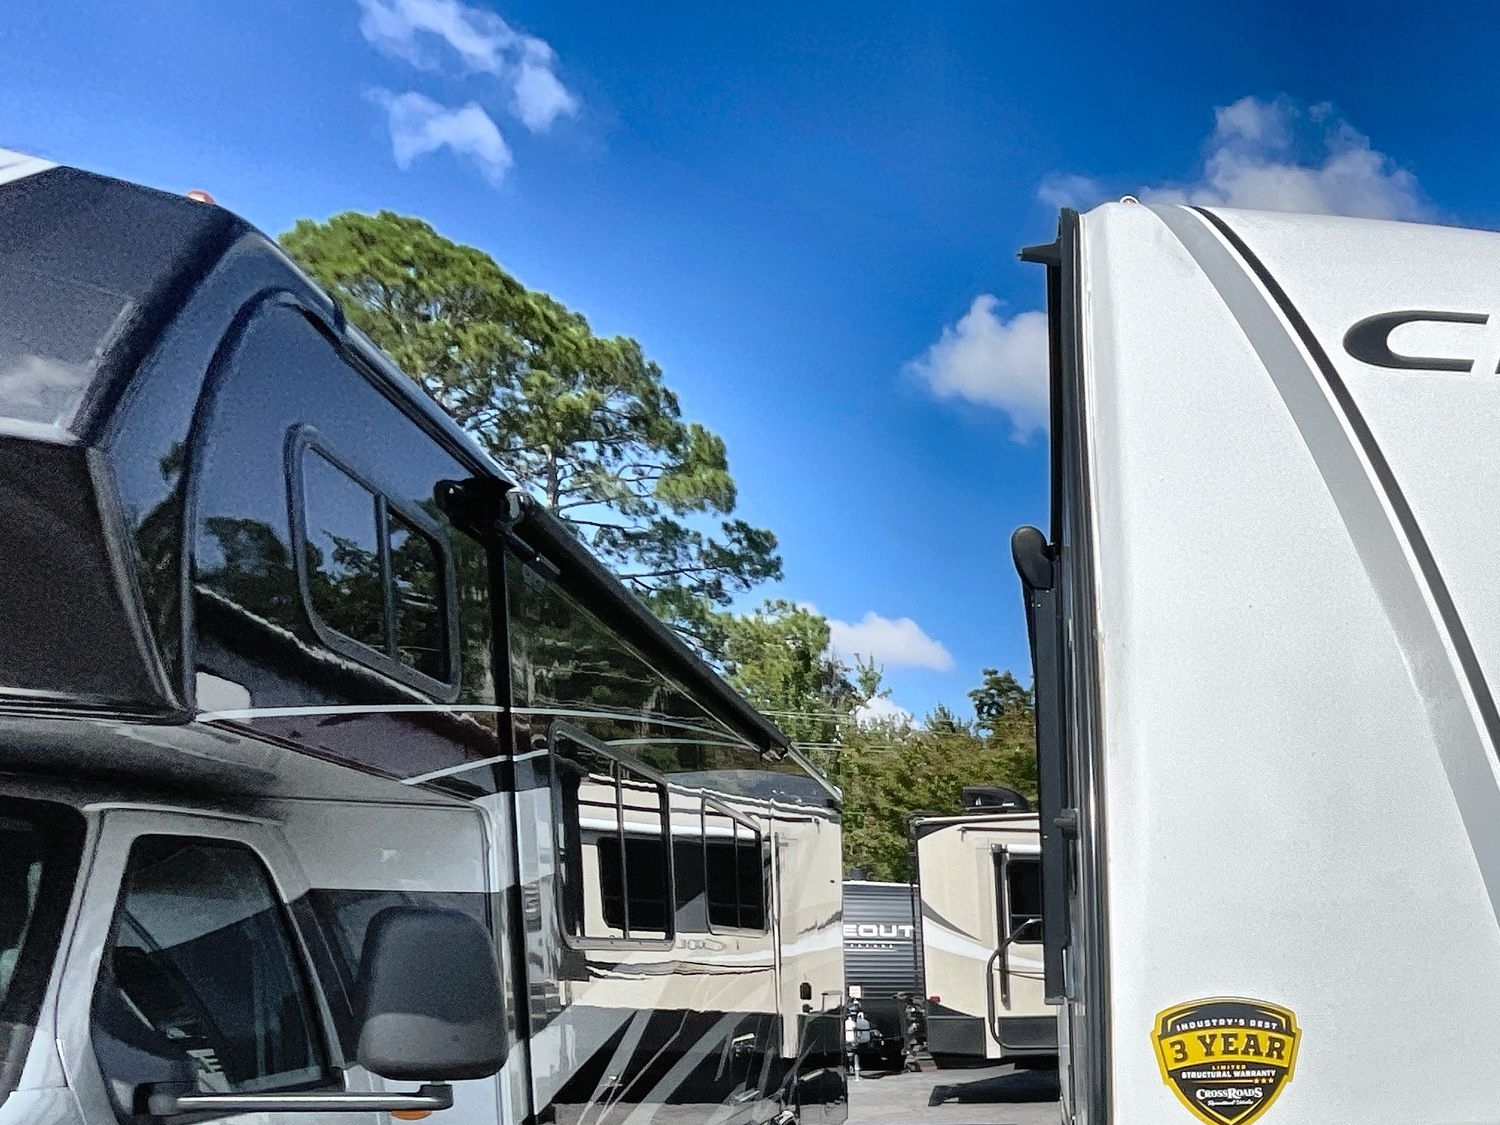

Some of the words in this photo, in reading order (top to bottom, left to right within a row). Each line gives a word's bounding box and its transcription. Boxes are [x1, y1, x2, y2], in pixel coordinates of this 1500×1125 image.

[1176, 1018, 1245, 1031] INDUSTRY'S
[1249, 1018, 1278, 1030] BEST
[1169, 1039, 1188, 1063] 3
[1197, 1032, 1285, 1060] YEAR
[1181, 1070, 1232, 1079] STRUCTURAL
[1233, 1069, 1277, 1078] WARRANTY
